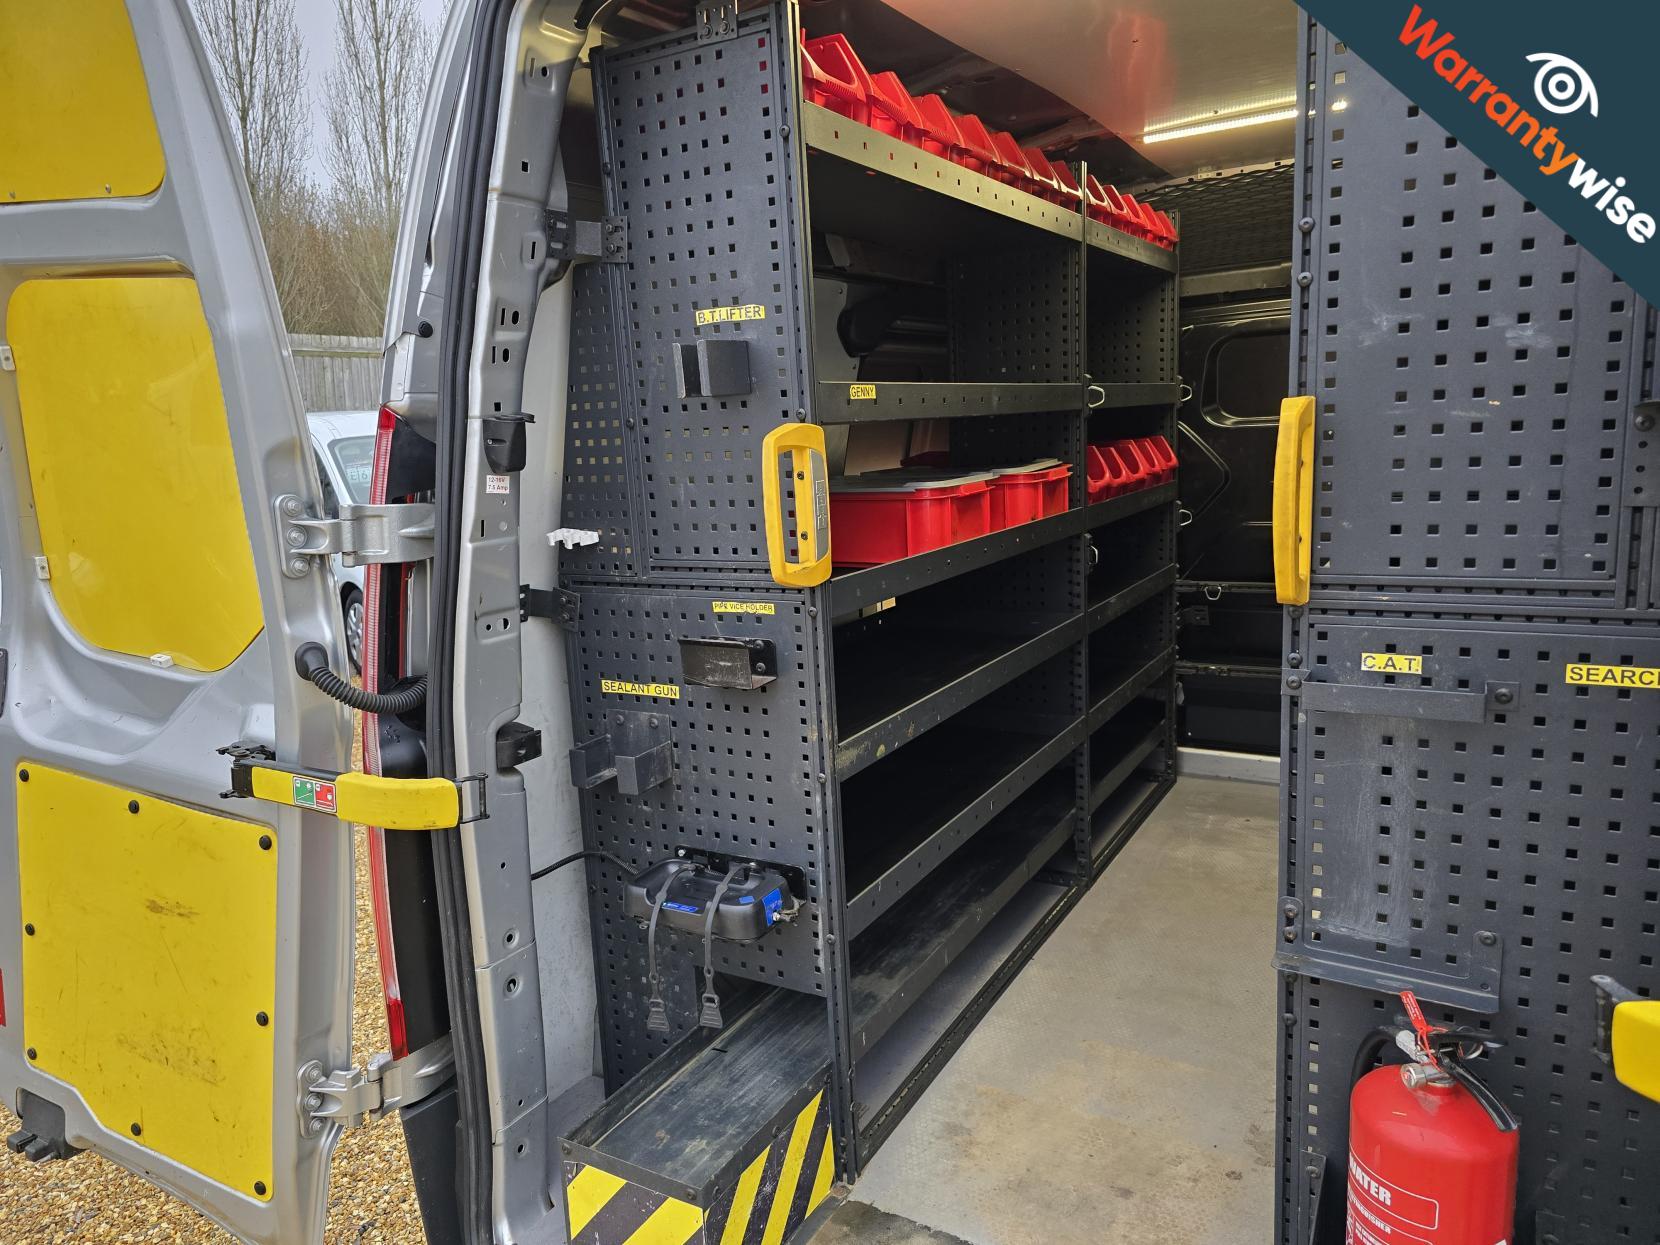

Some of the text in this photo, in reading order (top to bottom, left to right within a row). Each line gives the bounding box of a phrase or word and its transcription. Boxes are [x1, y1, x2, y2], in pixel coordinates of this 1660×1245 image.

[851, 386, 874, 398] GENNY
[729, 602, 744, 610] VICE
[745, 603, 773, 612] HOLDER
[1363, 655, 1419, 672] C.A.T.
[1569, 666, 1660, 686] SEARC
[603, 681, 677, 697] SEALANT GUN
[1349, 1152, 1391, 1206] WATER
[1347, 1184, 1392, 1234] TINGUISHER
